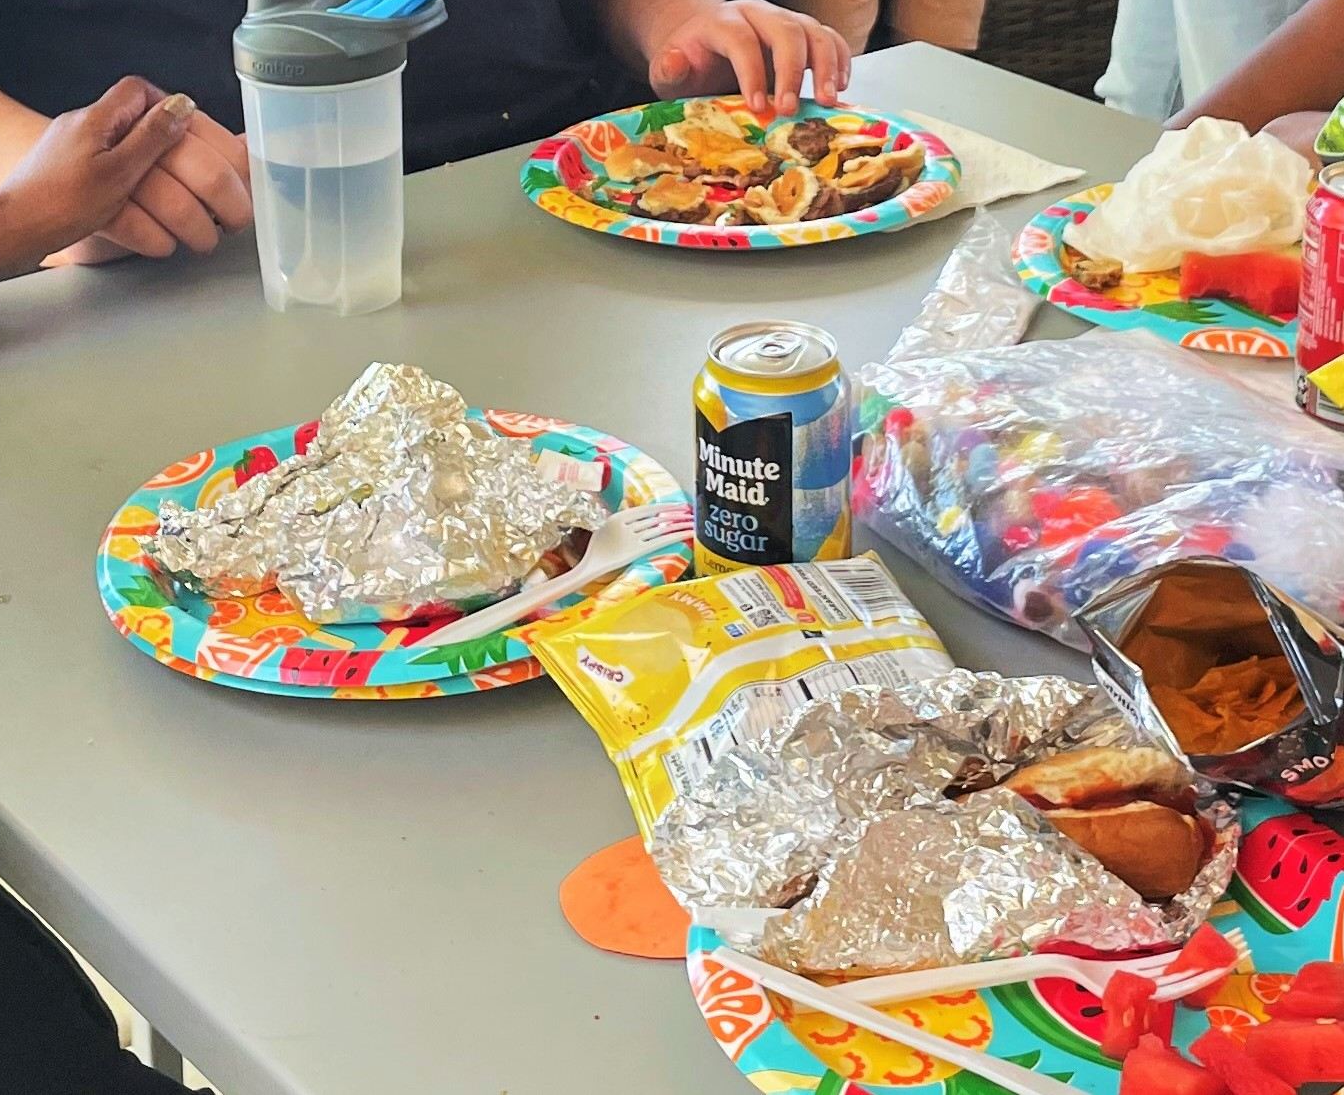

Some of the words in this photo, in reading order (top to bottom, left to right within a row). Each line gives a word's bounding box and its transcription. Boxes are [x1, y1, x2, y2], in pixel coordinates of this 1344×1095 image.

[698, 436, 781, 481] Minute
[705, 467, 770, 507] Maid
[708, 504, 758, 531] zero
[703, 521, 769, 553] sugar
[580, 654, 624, 682] CRISPY
